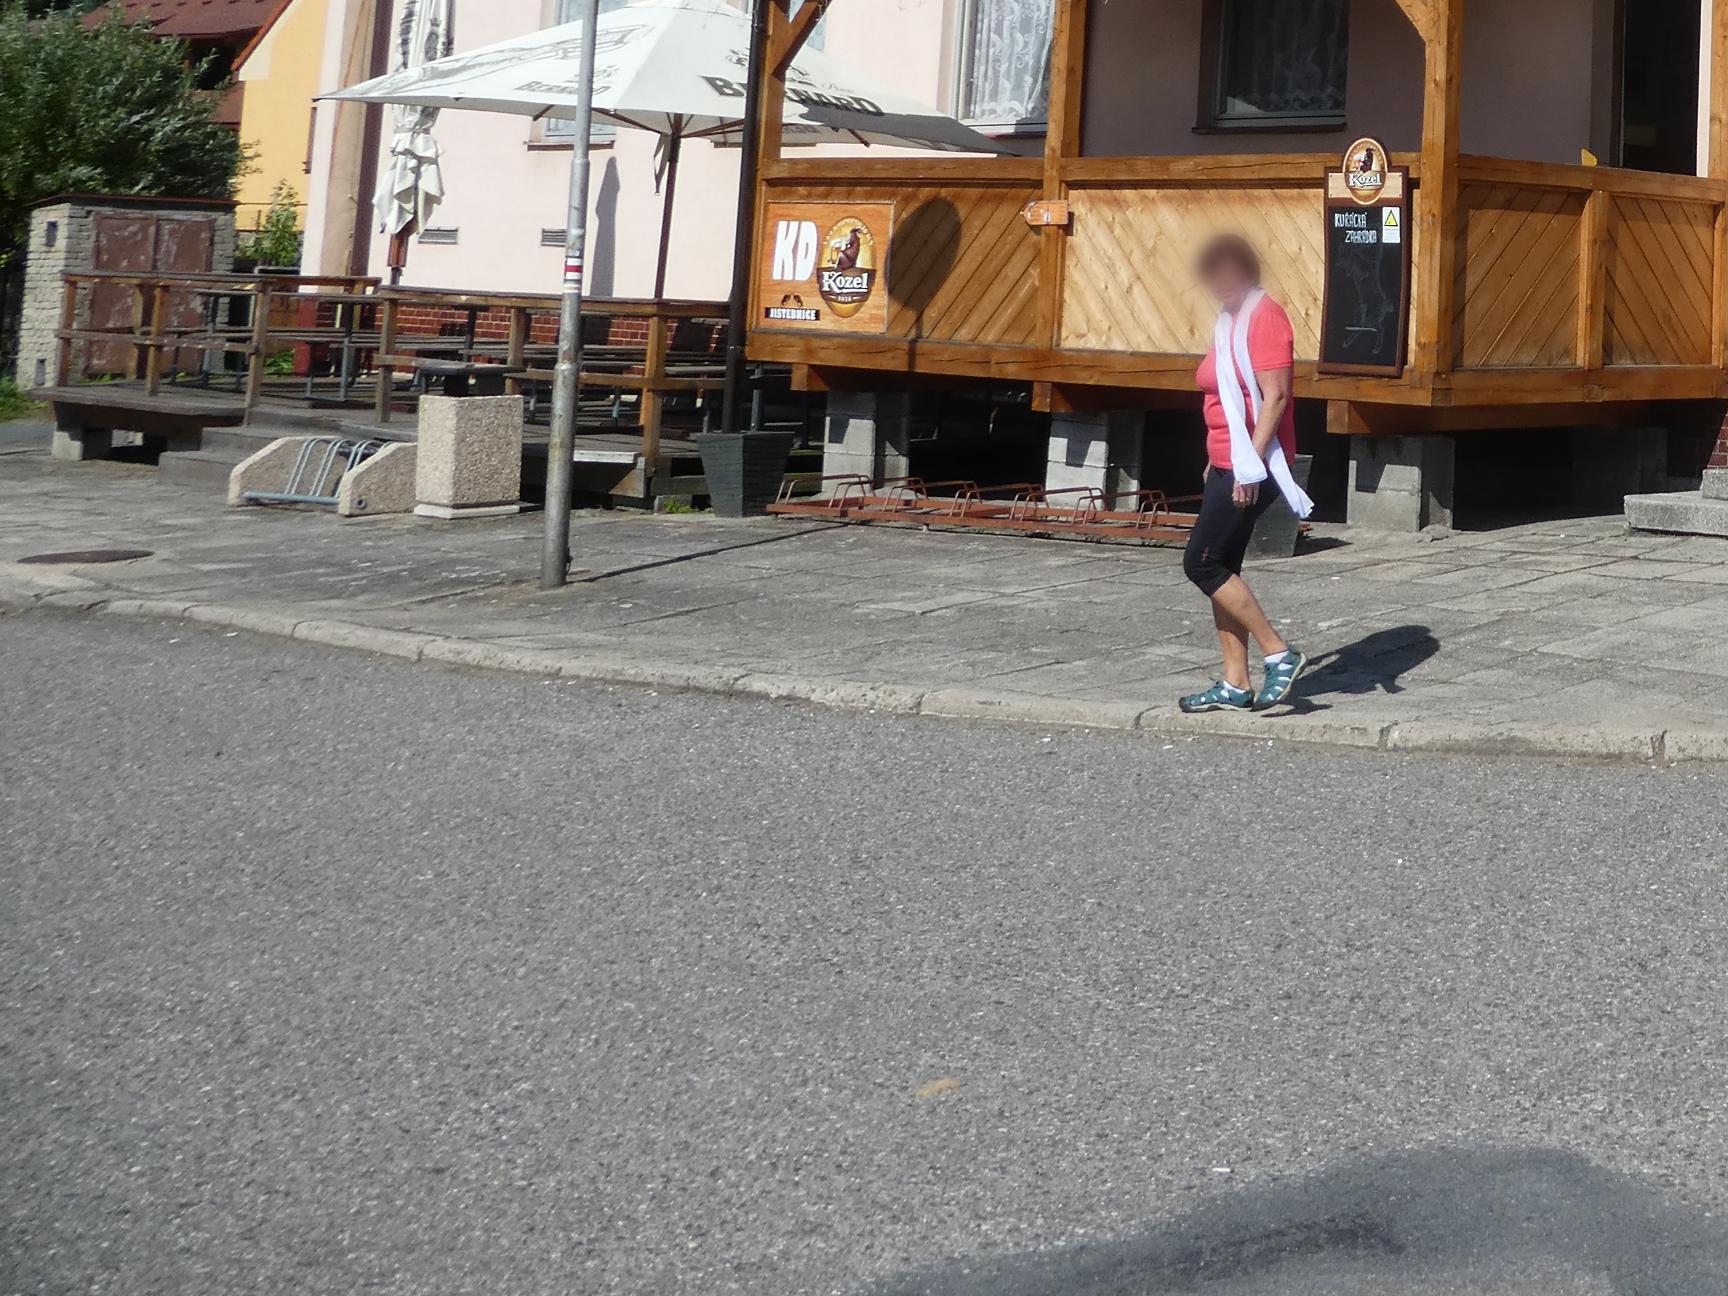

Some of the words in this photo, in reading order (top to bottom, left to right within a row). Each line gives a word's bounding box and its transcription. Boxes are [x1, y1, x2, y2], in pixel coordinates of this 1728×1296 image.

[699, 75, 885, 117] BNARD
[1348, 173, 1382, 186] Kozel
[771, 220, 818, 281] KD
[822, 271, 868, 294] Kozel
